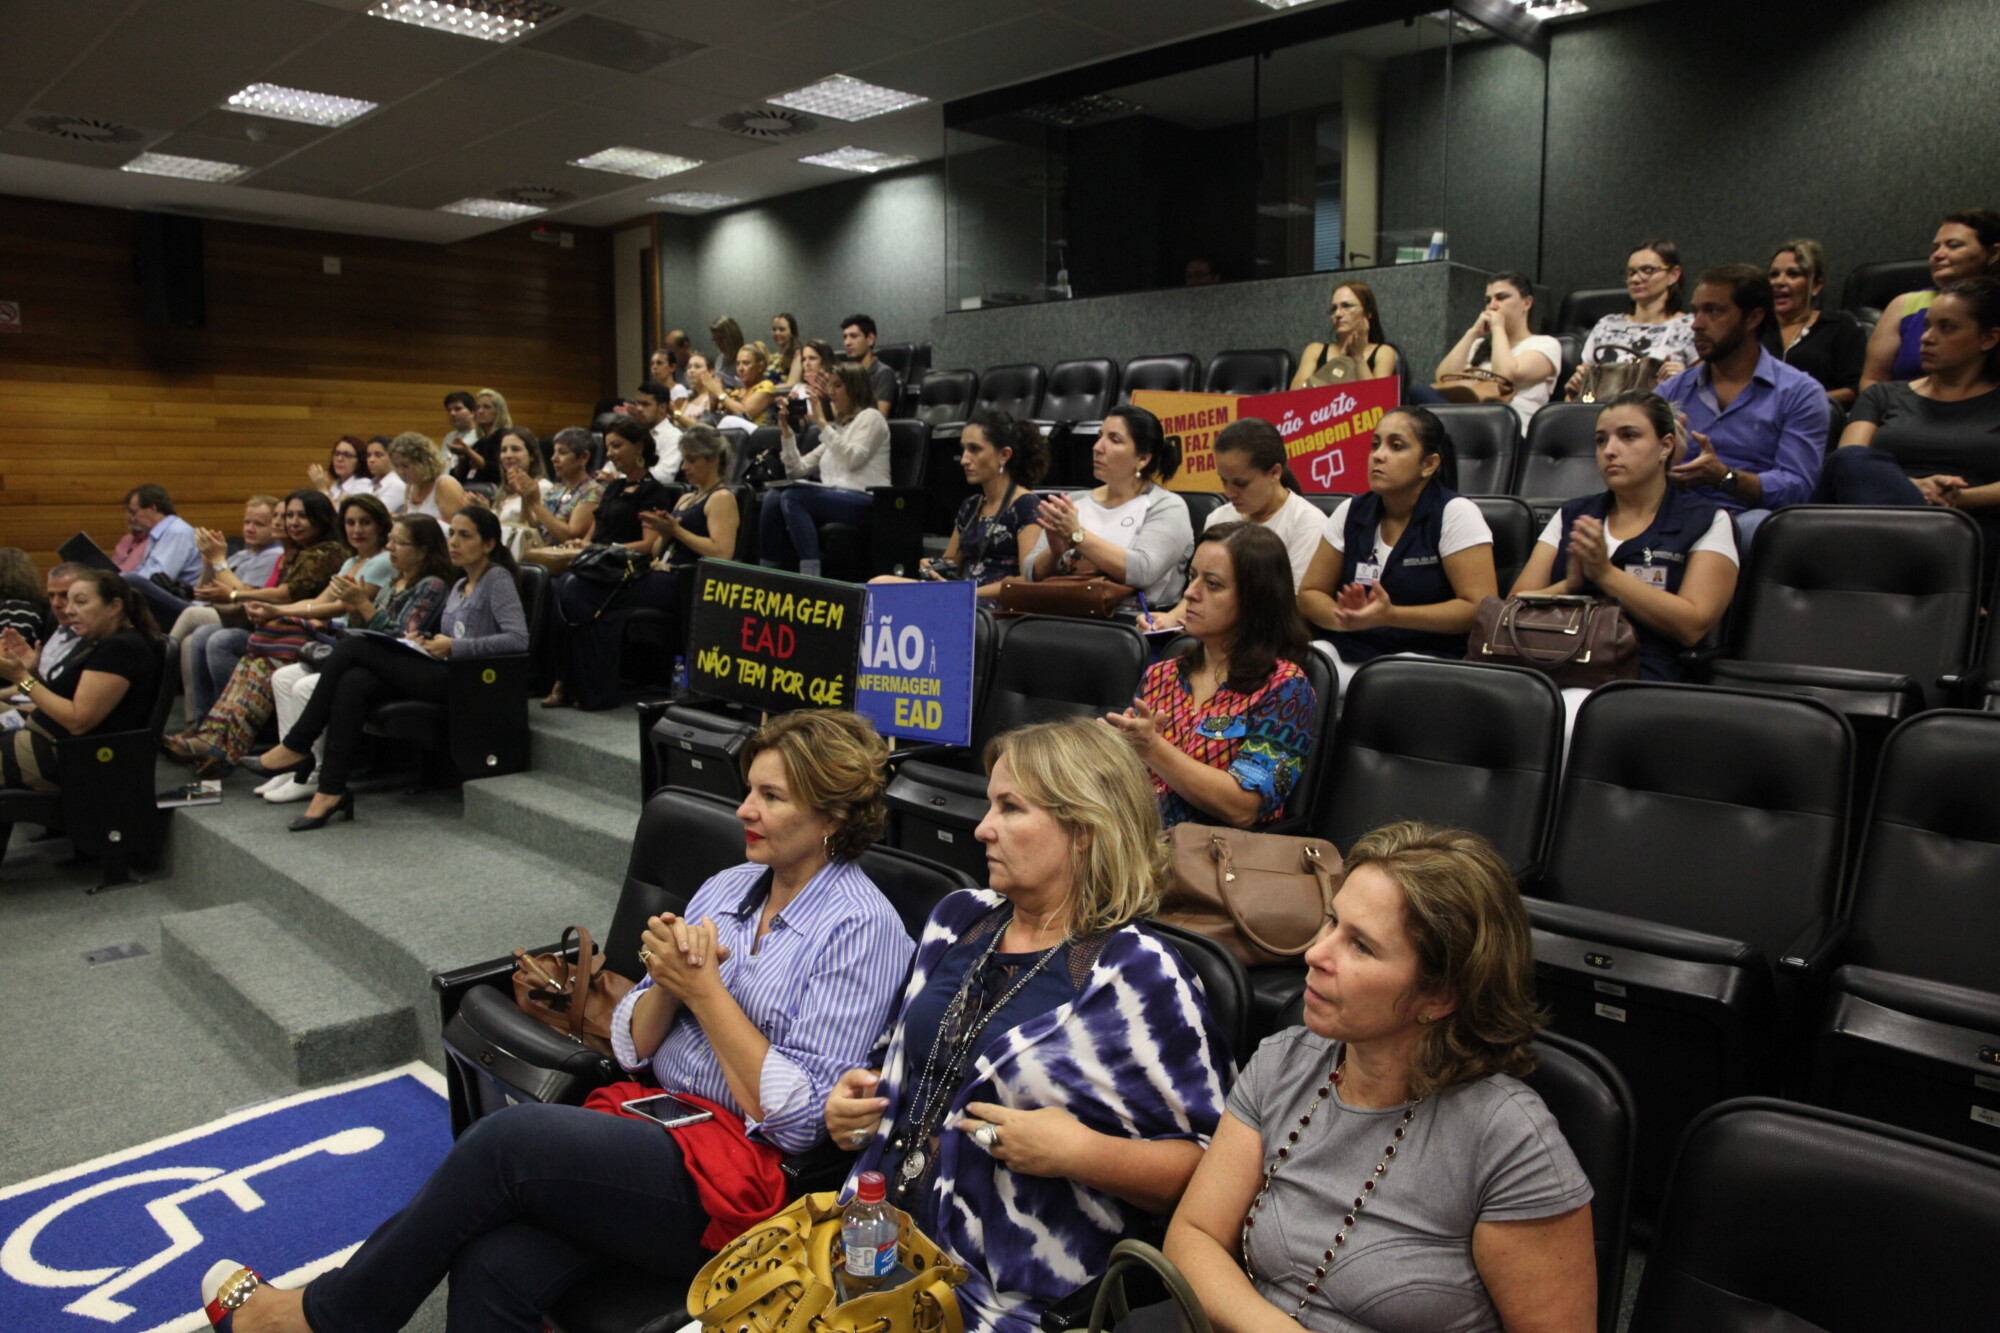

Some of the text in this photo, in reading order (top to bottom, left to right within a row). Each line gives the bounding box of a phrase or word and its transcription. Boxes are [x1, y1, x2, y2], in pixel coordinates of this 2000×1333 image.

[1160, 407, 1228, 434] RMAGEM
[1310, 391, 1357, 425] curto
[1352, 406, 1384, 435] EAD
[1185, 433, 1210, 453] FAZ
[1186, 453, 1216, 474] PRA
[703, 579, 844, 630] ENFERMAGEM
[741, 617, 795, 659] EAD
[697, 645, 843, 705] NÃO TEM POR QUÊ
[895, 698, 942, 730] EAD
[1594, 956, 1603, 965] 16
